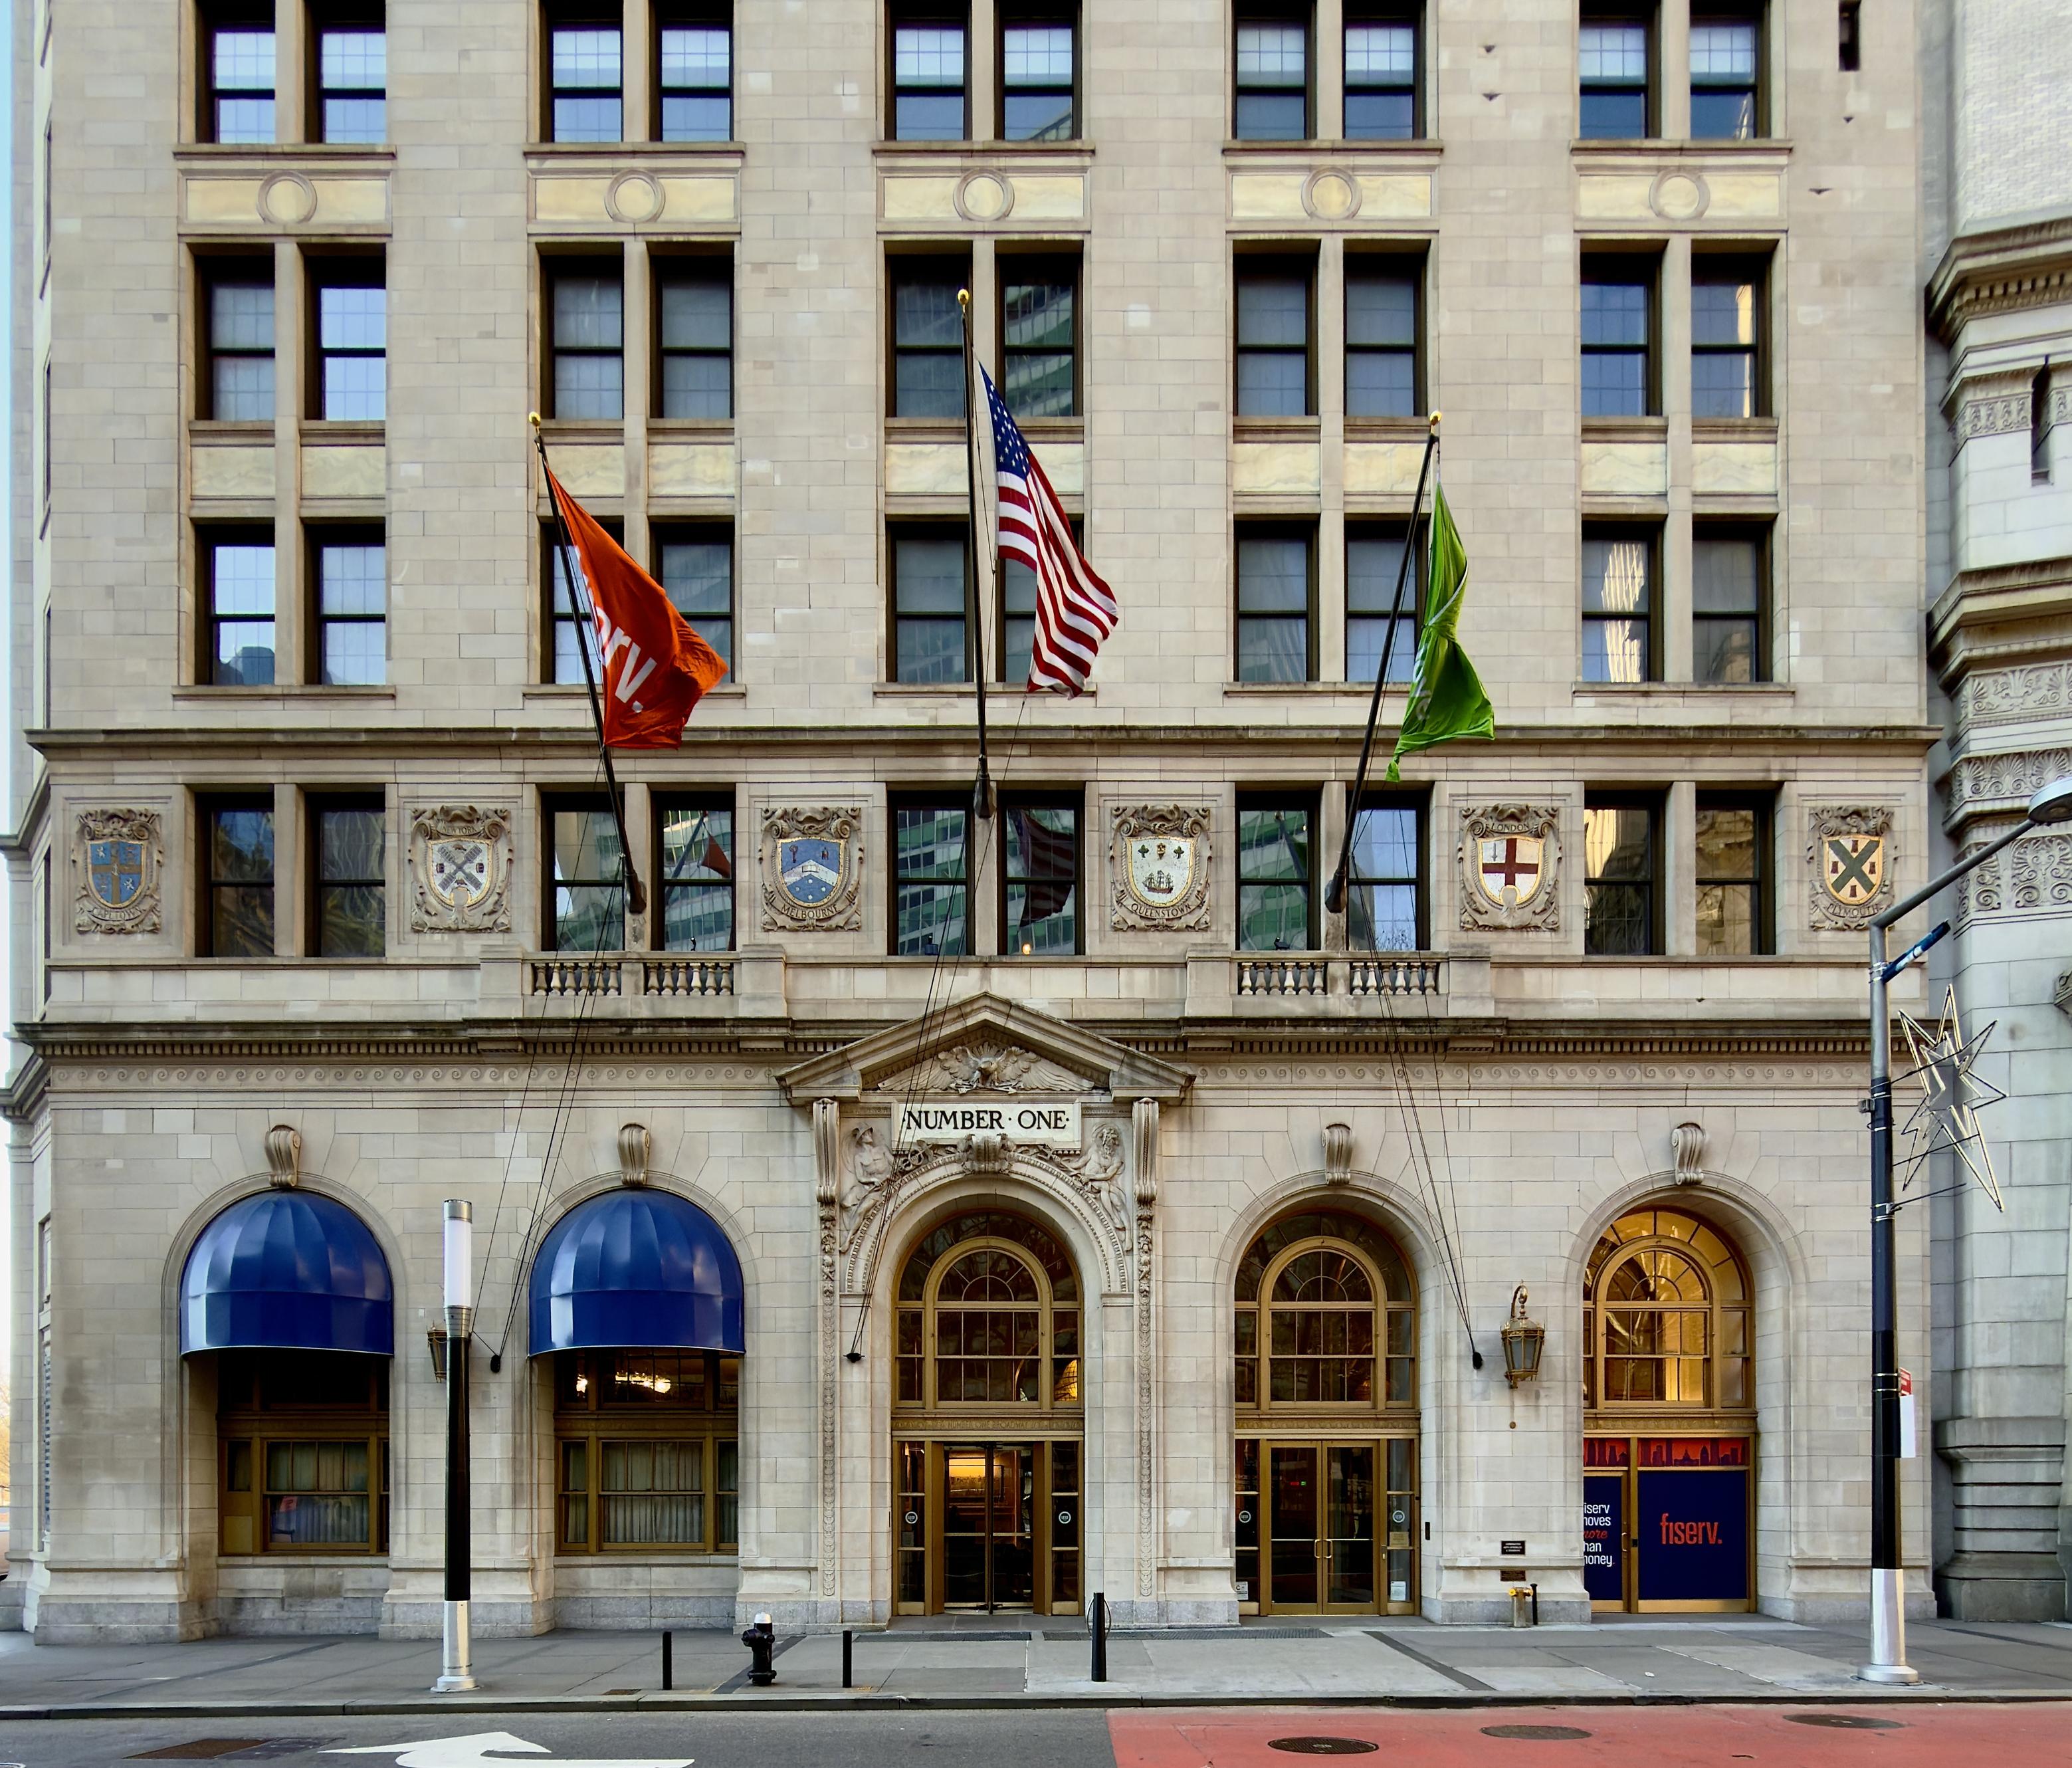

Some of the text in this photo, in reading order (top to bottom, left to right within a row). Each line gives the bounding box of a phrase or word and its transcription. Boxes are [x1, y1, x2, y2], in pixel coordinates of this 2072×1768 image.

[457, 826, 477, 835] YORK
[1491, 822, 1529, 832] LONDON
[781, 904, 838, 919] MELBOURNE
[1131, 903, 1191, 917] QUEENSTOWN
[1827, 903, 1879, 916] PLYMOUTH
[906, 1109, 1067, 1130] NUMBER ONE
[1584, 1502, 1610, 1514] iserv
[1660, 1513, 1722, 1545] fiserv.
[1584, 1542, 1602, 1552] han
